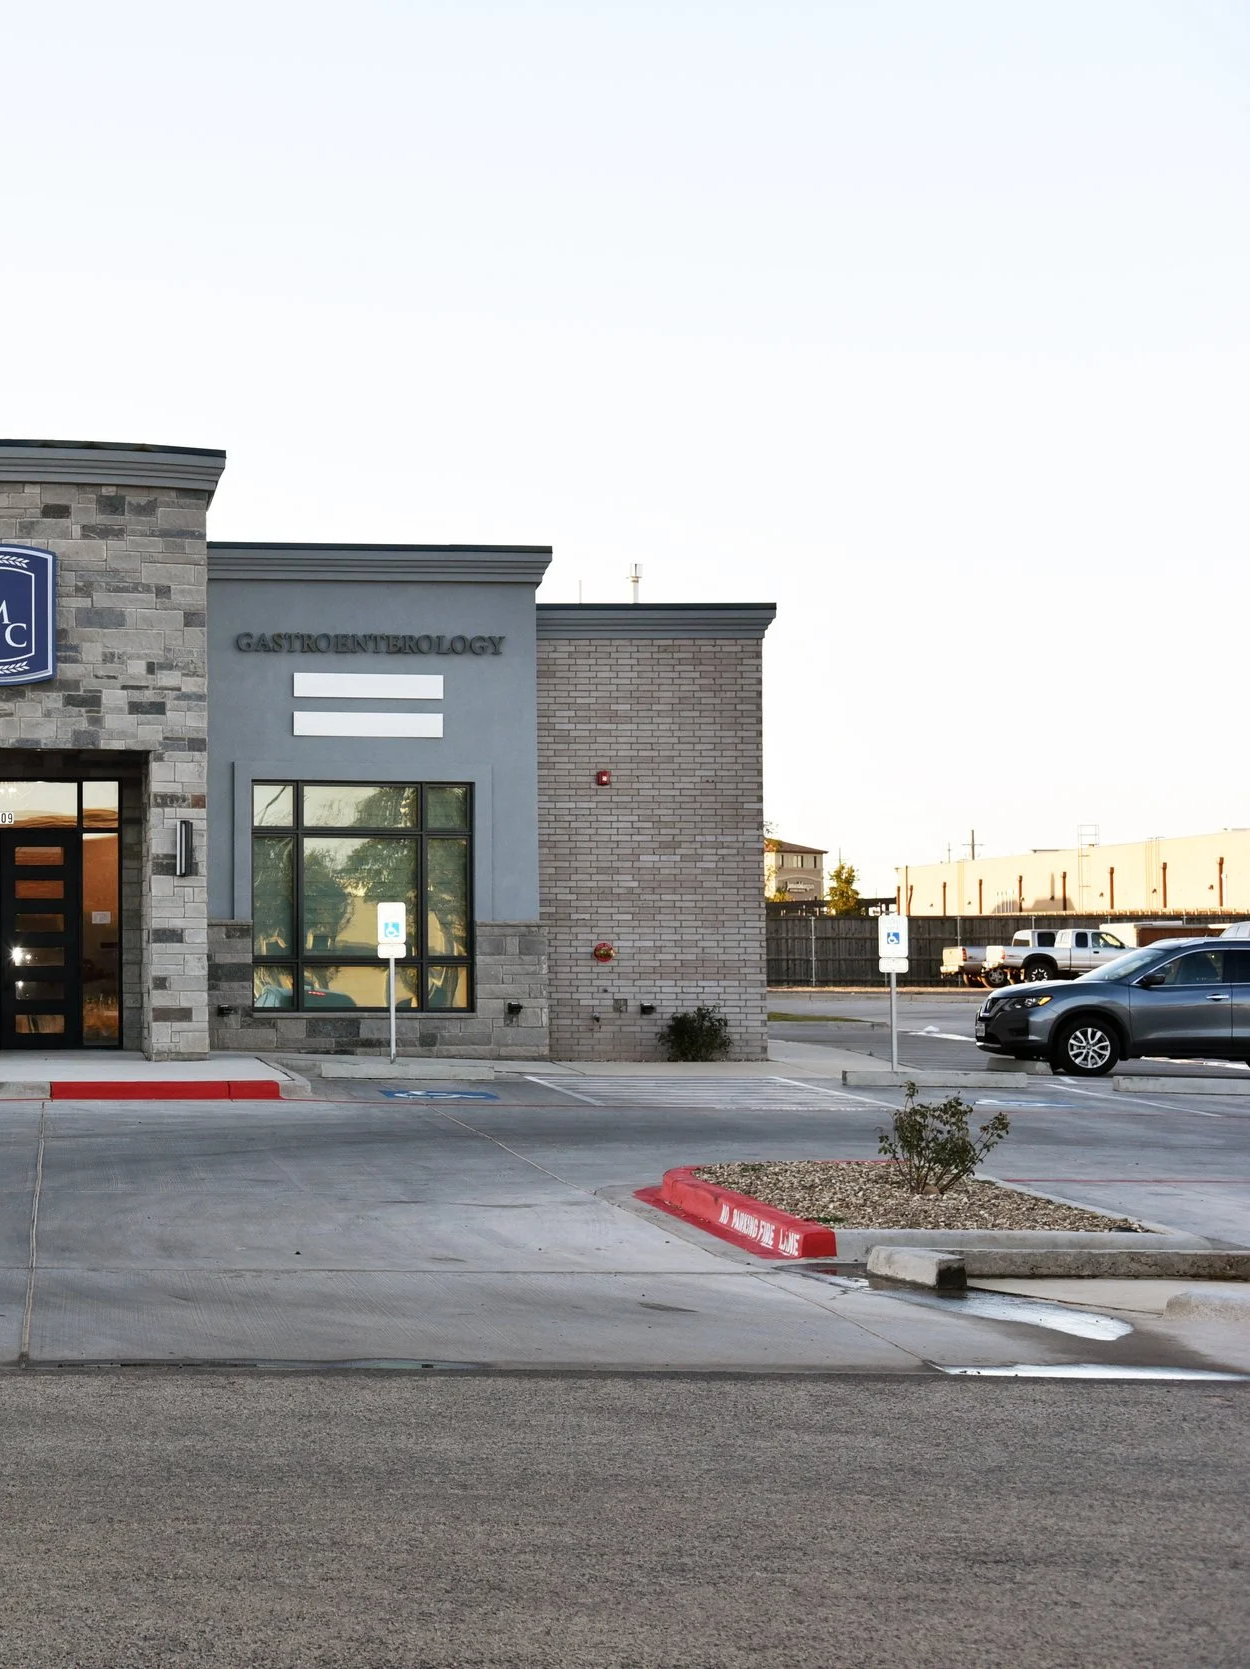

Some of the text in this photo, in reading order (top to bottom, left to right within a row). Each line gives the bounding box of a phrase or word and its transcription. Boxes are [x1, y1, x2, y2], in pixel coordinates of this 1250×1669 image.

[235, 632, 506, 656] GASTROENTEROLOGY
[718, 1203, 800, 1257] NO PARKING FIRE LANE
